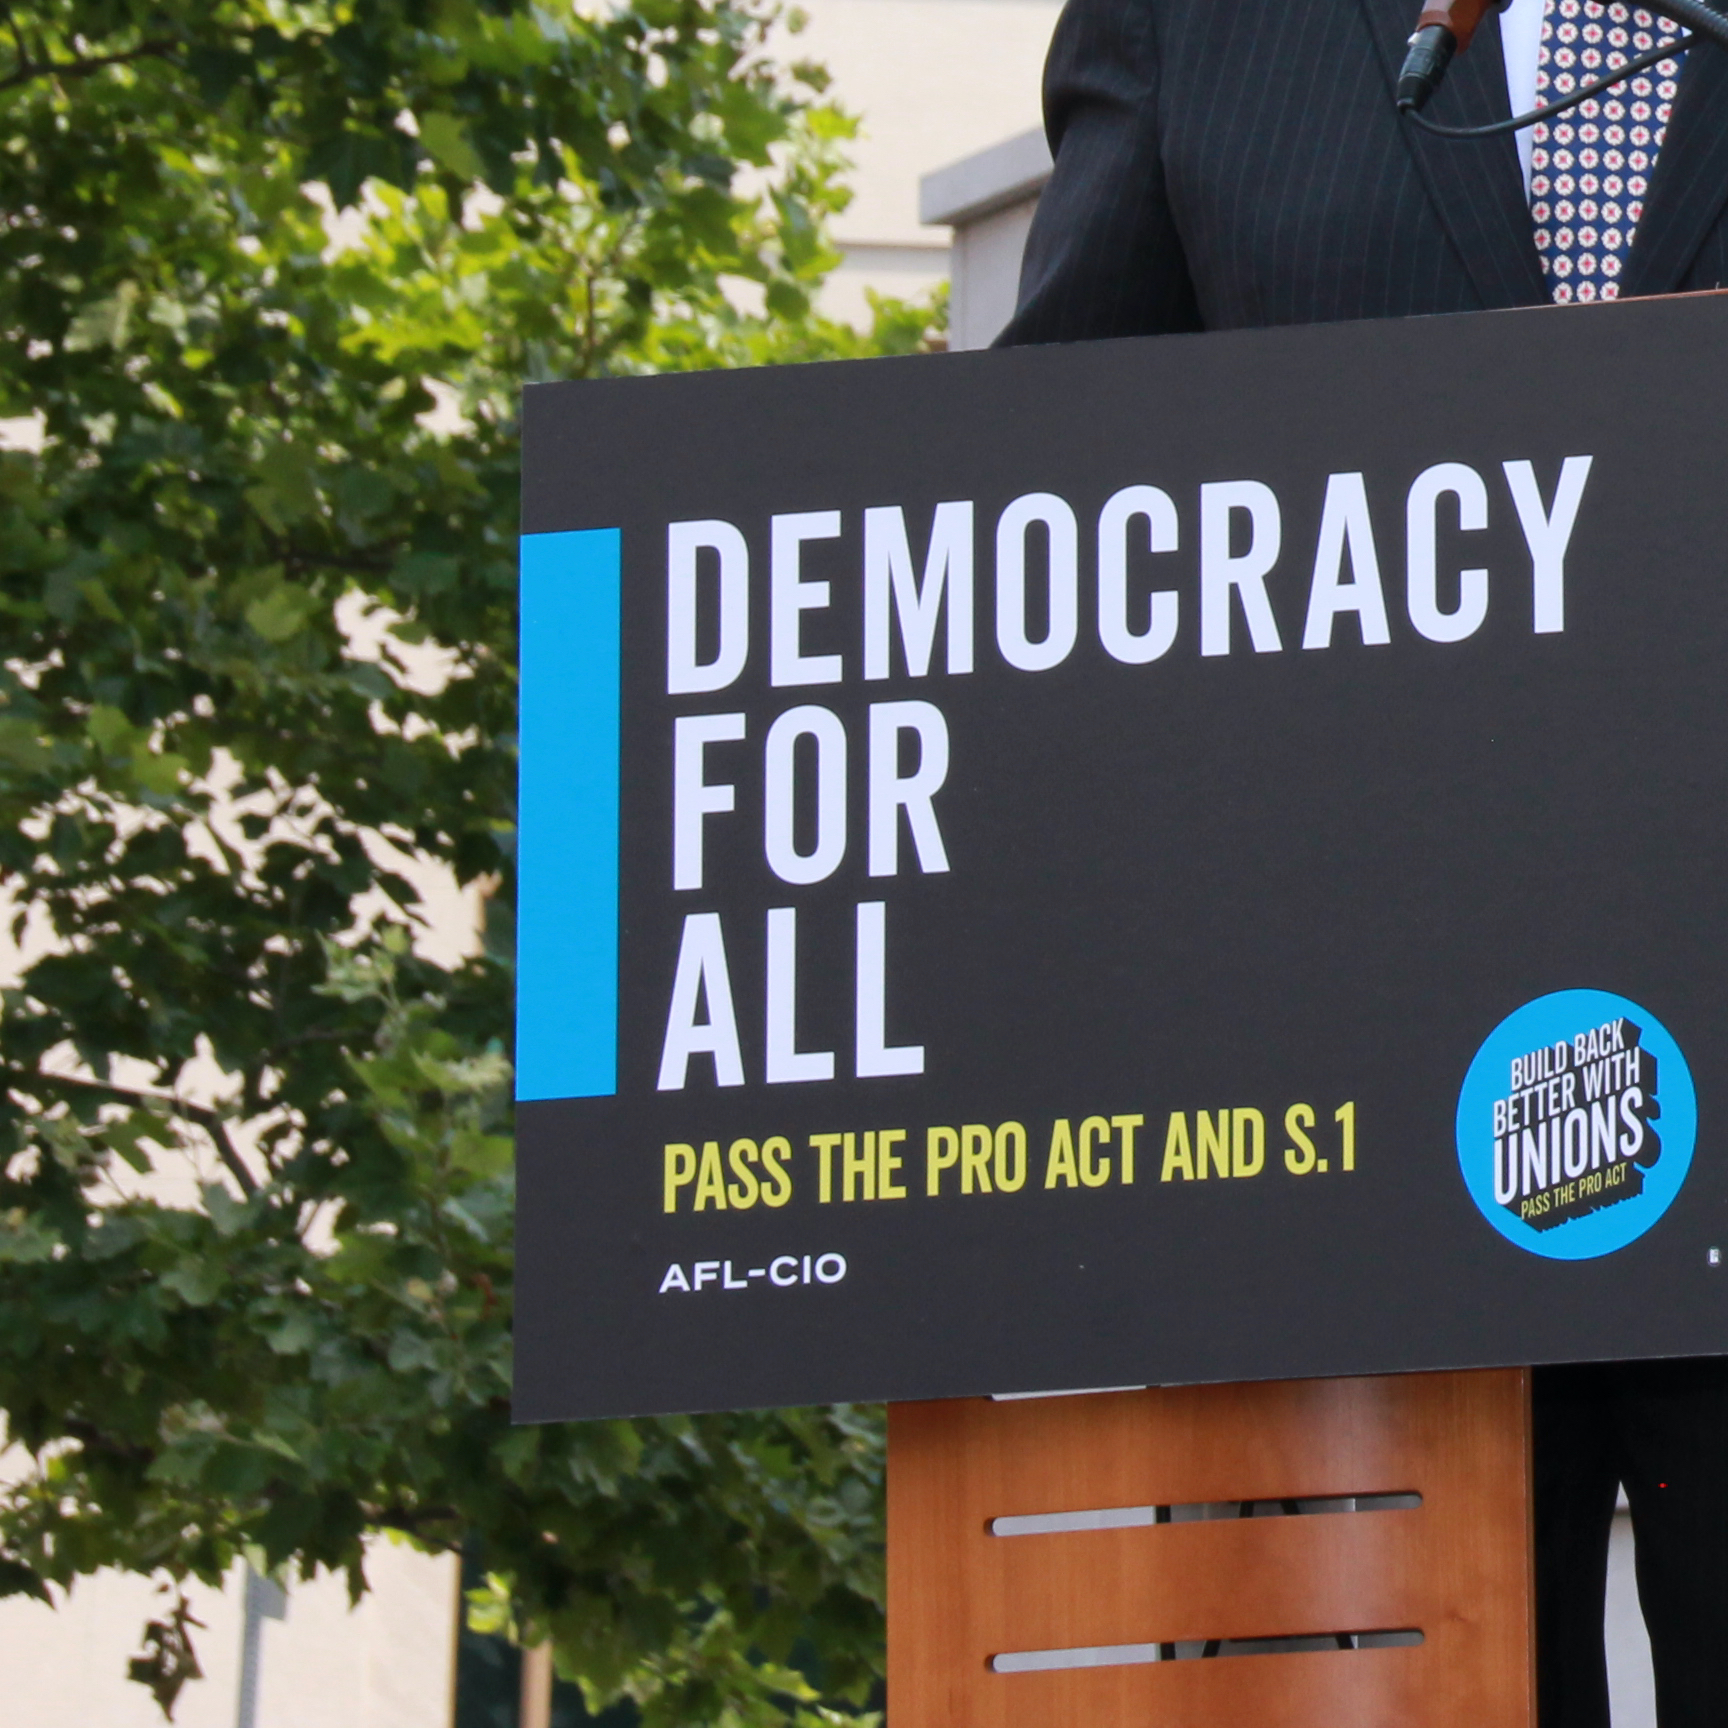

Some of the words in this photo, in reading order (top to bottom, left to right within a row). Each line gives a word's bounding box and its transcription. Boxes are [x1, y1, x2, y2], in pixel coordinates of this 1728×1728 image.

[668, 456, 1593, 695] DEMOCRACY
[673, 700, 951, 891] FOR
[656, 901, 925, 1092] ALL
[1494, 1072, 1576, 1138] BETTER
[1583, 1046, 1640, 1102] WITH
[1511, 1040, 1567, 1091] BUILD
[1574, 1017, 1625, 1066] BACK
[662, 1140, 792, 1213] PASS
[809, 1129, 906, 1203] THE
[927, 1121, 1026, 1196] PRO
[1045, 1114, 1143, 1189] ACT
[1161, 1108, 1264, 1182] AND
[1285, 1102, 1355, 1175] S.1
[1494, 1086, 1644, 1205] UNIONS
[1521, 1192, 1551, 1220] PASS
[1553, 1182, 1576, 1207] THE
[1579, 1172, 1602, 1198] PRO
[1605, 1162, 1628, 1188] ACT
[659, 1253, 847, 1294] AFL-CIO
